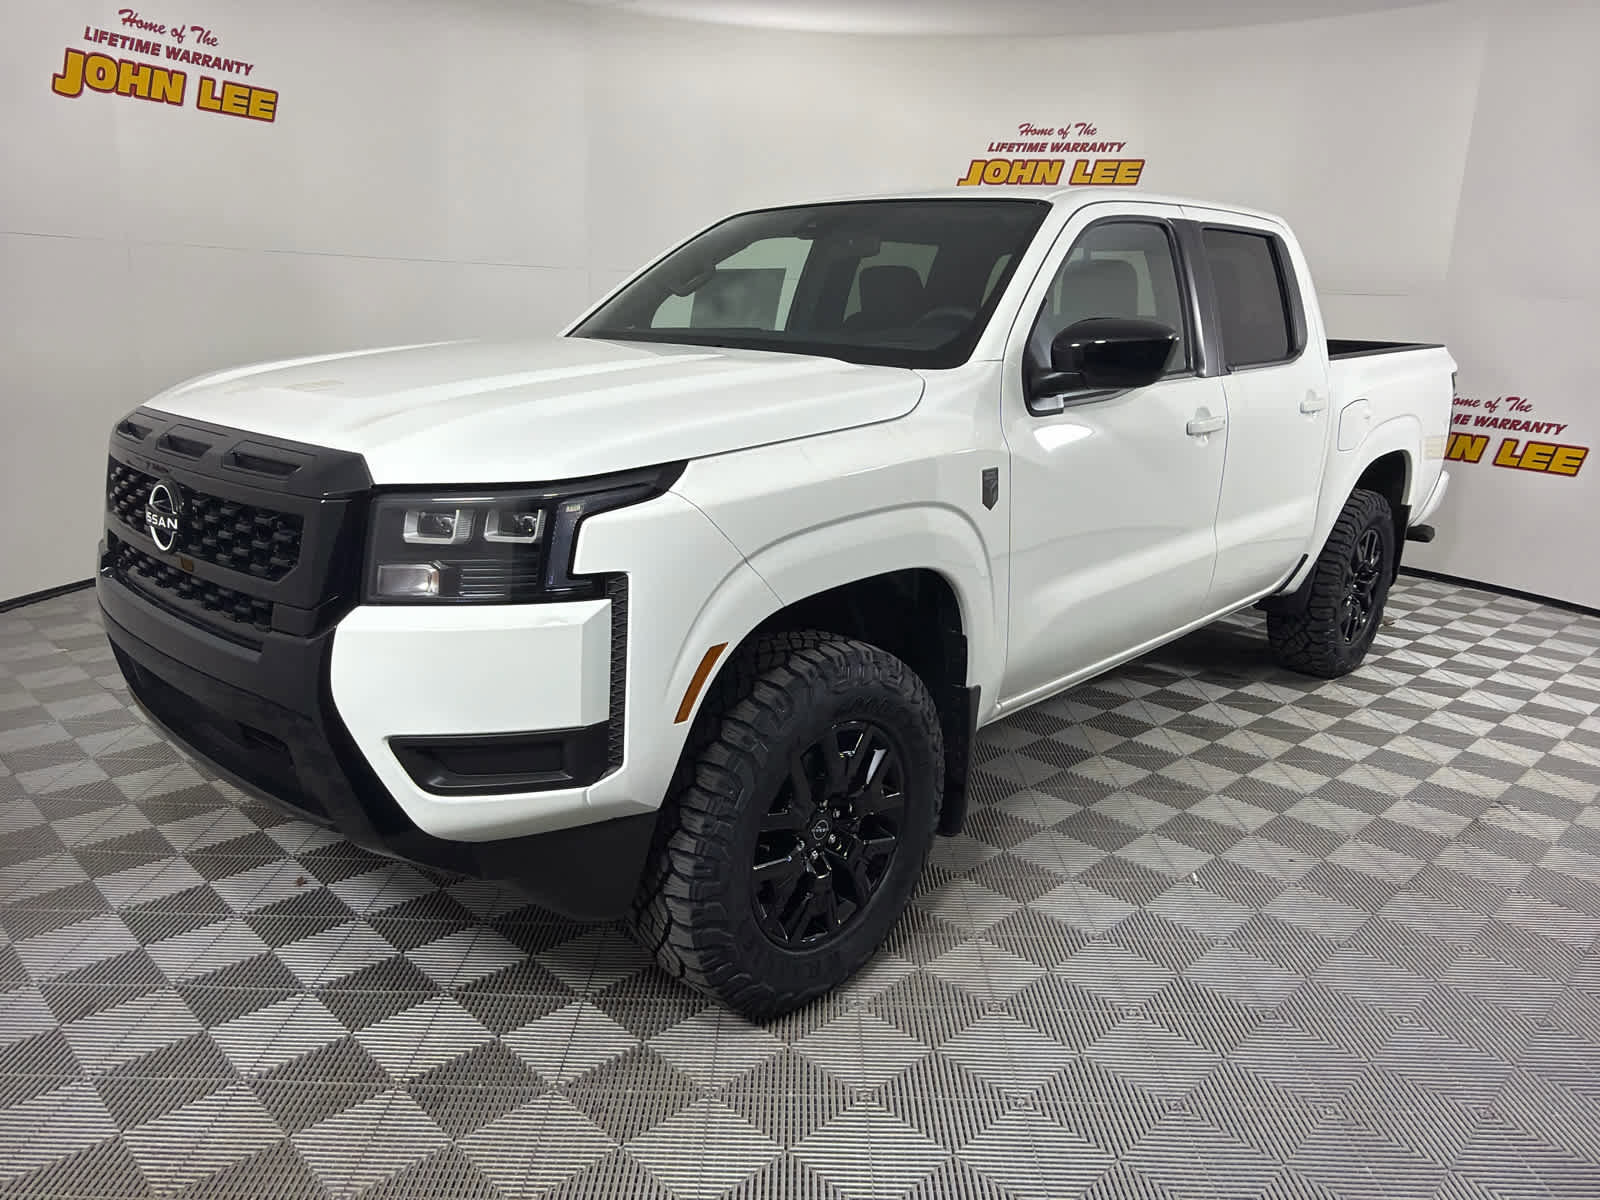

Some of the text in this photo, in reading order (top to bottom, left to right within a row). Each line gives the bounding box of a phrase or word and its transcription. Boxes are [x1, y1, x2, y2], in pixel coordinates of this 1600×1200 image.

[118, 9, 219, 47] Home of The
[84, 26, 254, 76] LIFETIME WARRANTY
[52, 47, 279, 123] JOHN LEE
[1018, 122, 1097, 139] Home of The
[987, 142, 1127, 153] LIFETIME WARRANTY
[956, 159, 1145, 186] JOHN LEE
[1453, 394, 1533, 413] ome of The
[1473, 415, 1568, 435] WARRANTY
[1492, 438, 1589, 477] LEE
[146, 511, 178, 530] SSAN
